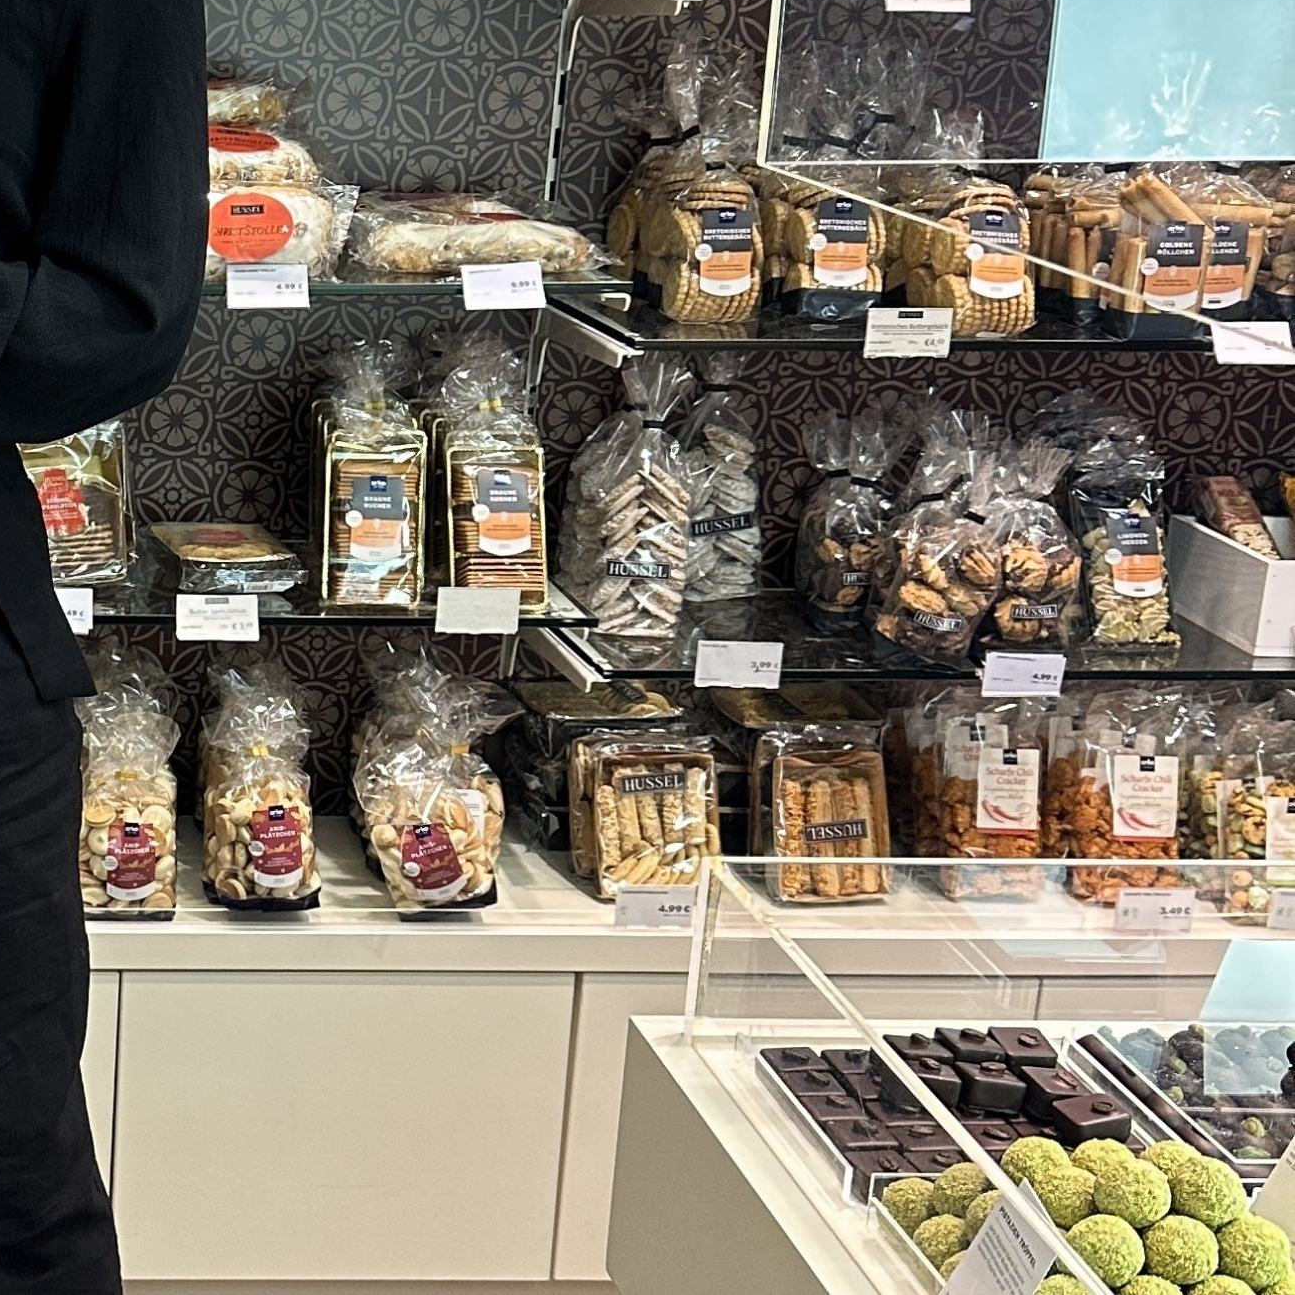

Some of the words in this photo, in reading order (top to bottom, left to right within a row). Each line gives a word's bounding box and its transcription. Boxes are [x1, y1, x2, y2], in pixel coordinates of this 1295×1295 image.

[694, 517, 750, 534] HUSSEL
[609, 563, 667, 577] HUSSEL
[1014, 606, 1055, 618] HUSSEL
[917, 614, 959, 630] HUSSEL
[986, 767, 1015, 776] Scharfe
[1016, 767, 1034, 776] Chili
[624, 775, 683, 791] HUSSEL
[997, 777, 1027, 785] Cracker
[1121, 774, 1151, 784] Scharfe
[1154, 774, 1172, 784] Chili
[1132, 784, 1163, 792] Cracker
[807, 822, 864, 839] HUSSEL
[658, 905, 681, 913] 4.99
[1159, 907, 1182, 915] 3.49
[999, 1206, 1021, 1240] PISTAZIEN
[1019, 1238, 1036, 1269] TRÜFFEL
